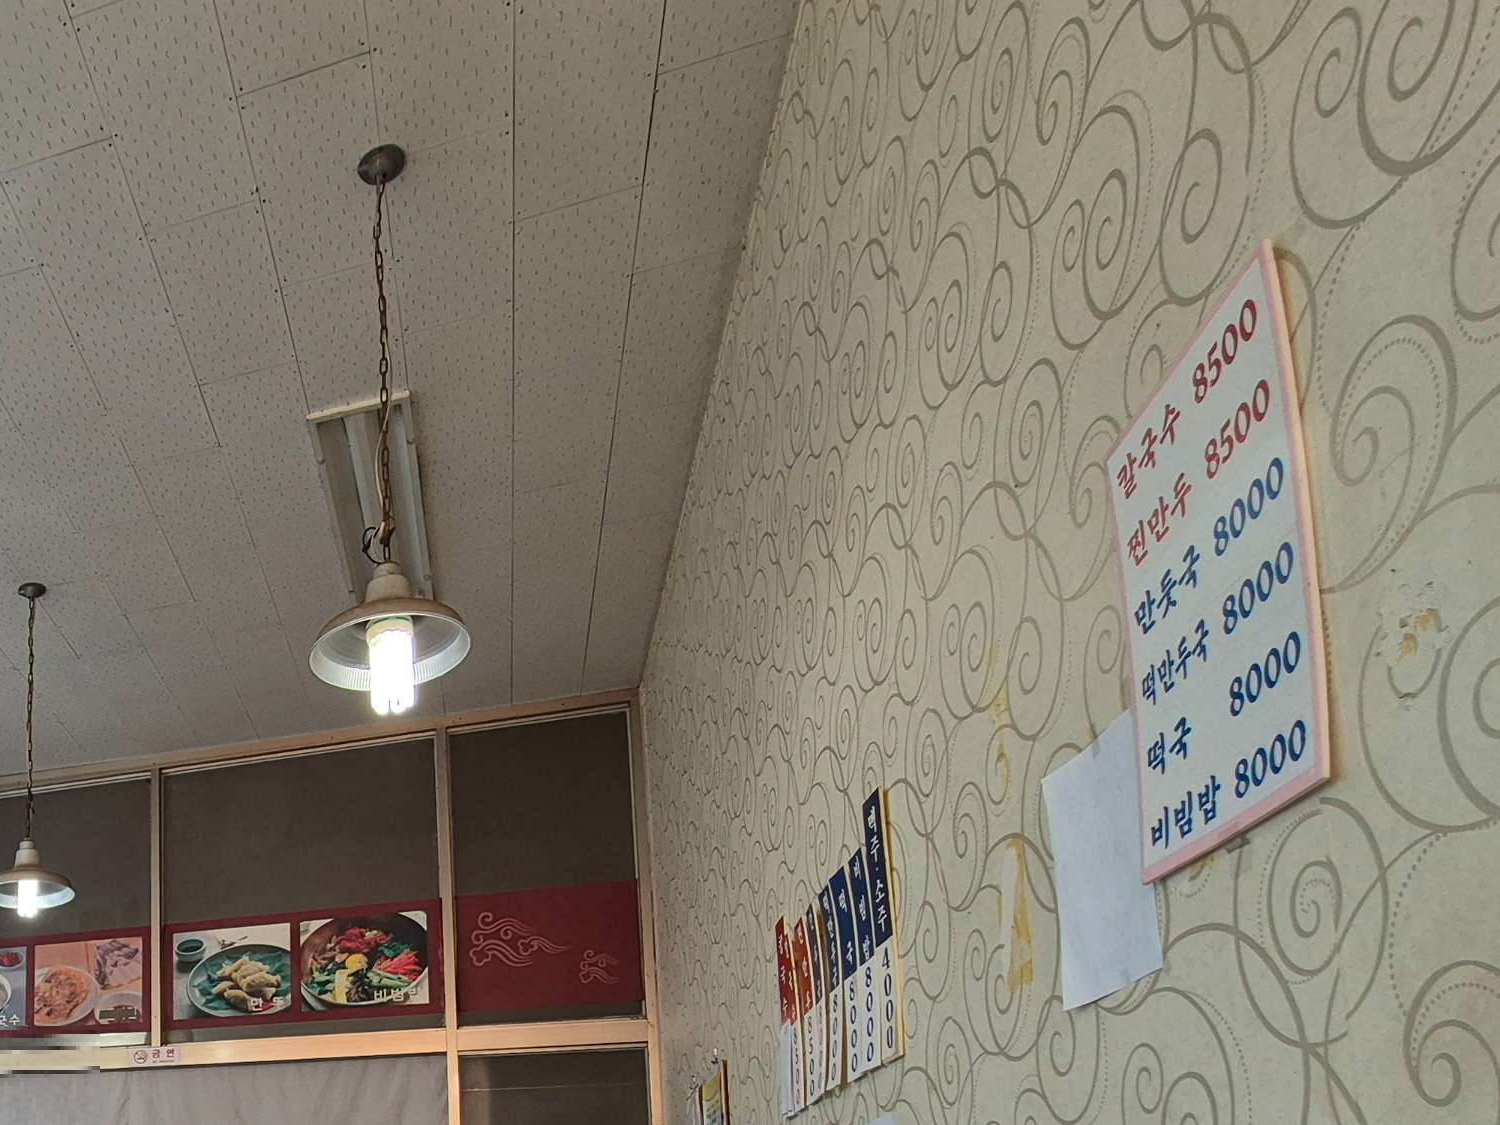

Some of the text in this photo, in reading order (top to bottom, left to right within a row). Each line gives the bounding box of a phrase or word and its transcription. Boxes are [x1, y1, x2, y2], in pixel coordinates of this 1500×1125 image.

[1117, 299, 1258, 499] 칼국수 8500
[1127, 379, 1271, 567] 찐만두 8500
[1134, 457, 1284, 634] 만둣국 8000
[1141, 541, 1294, 705] 떡만두국 8000
[1148, 631, 1300, 774] 떡국 8000
[1151, 720, 1306, 850] 비빔밥 8000
[831, 993, 839, 1081] 8000
[849, 981, 858, 1073] 8000
[865, 967, 875, 1062] 8000
[882, 947, 894, 1049] 4000
